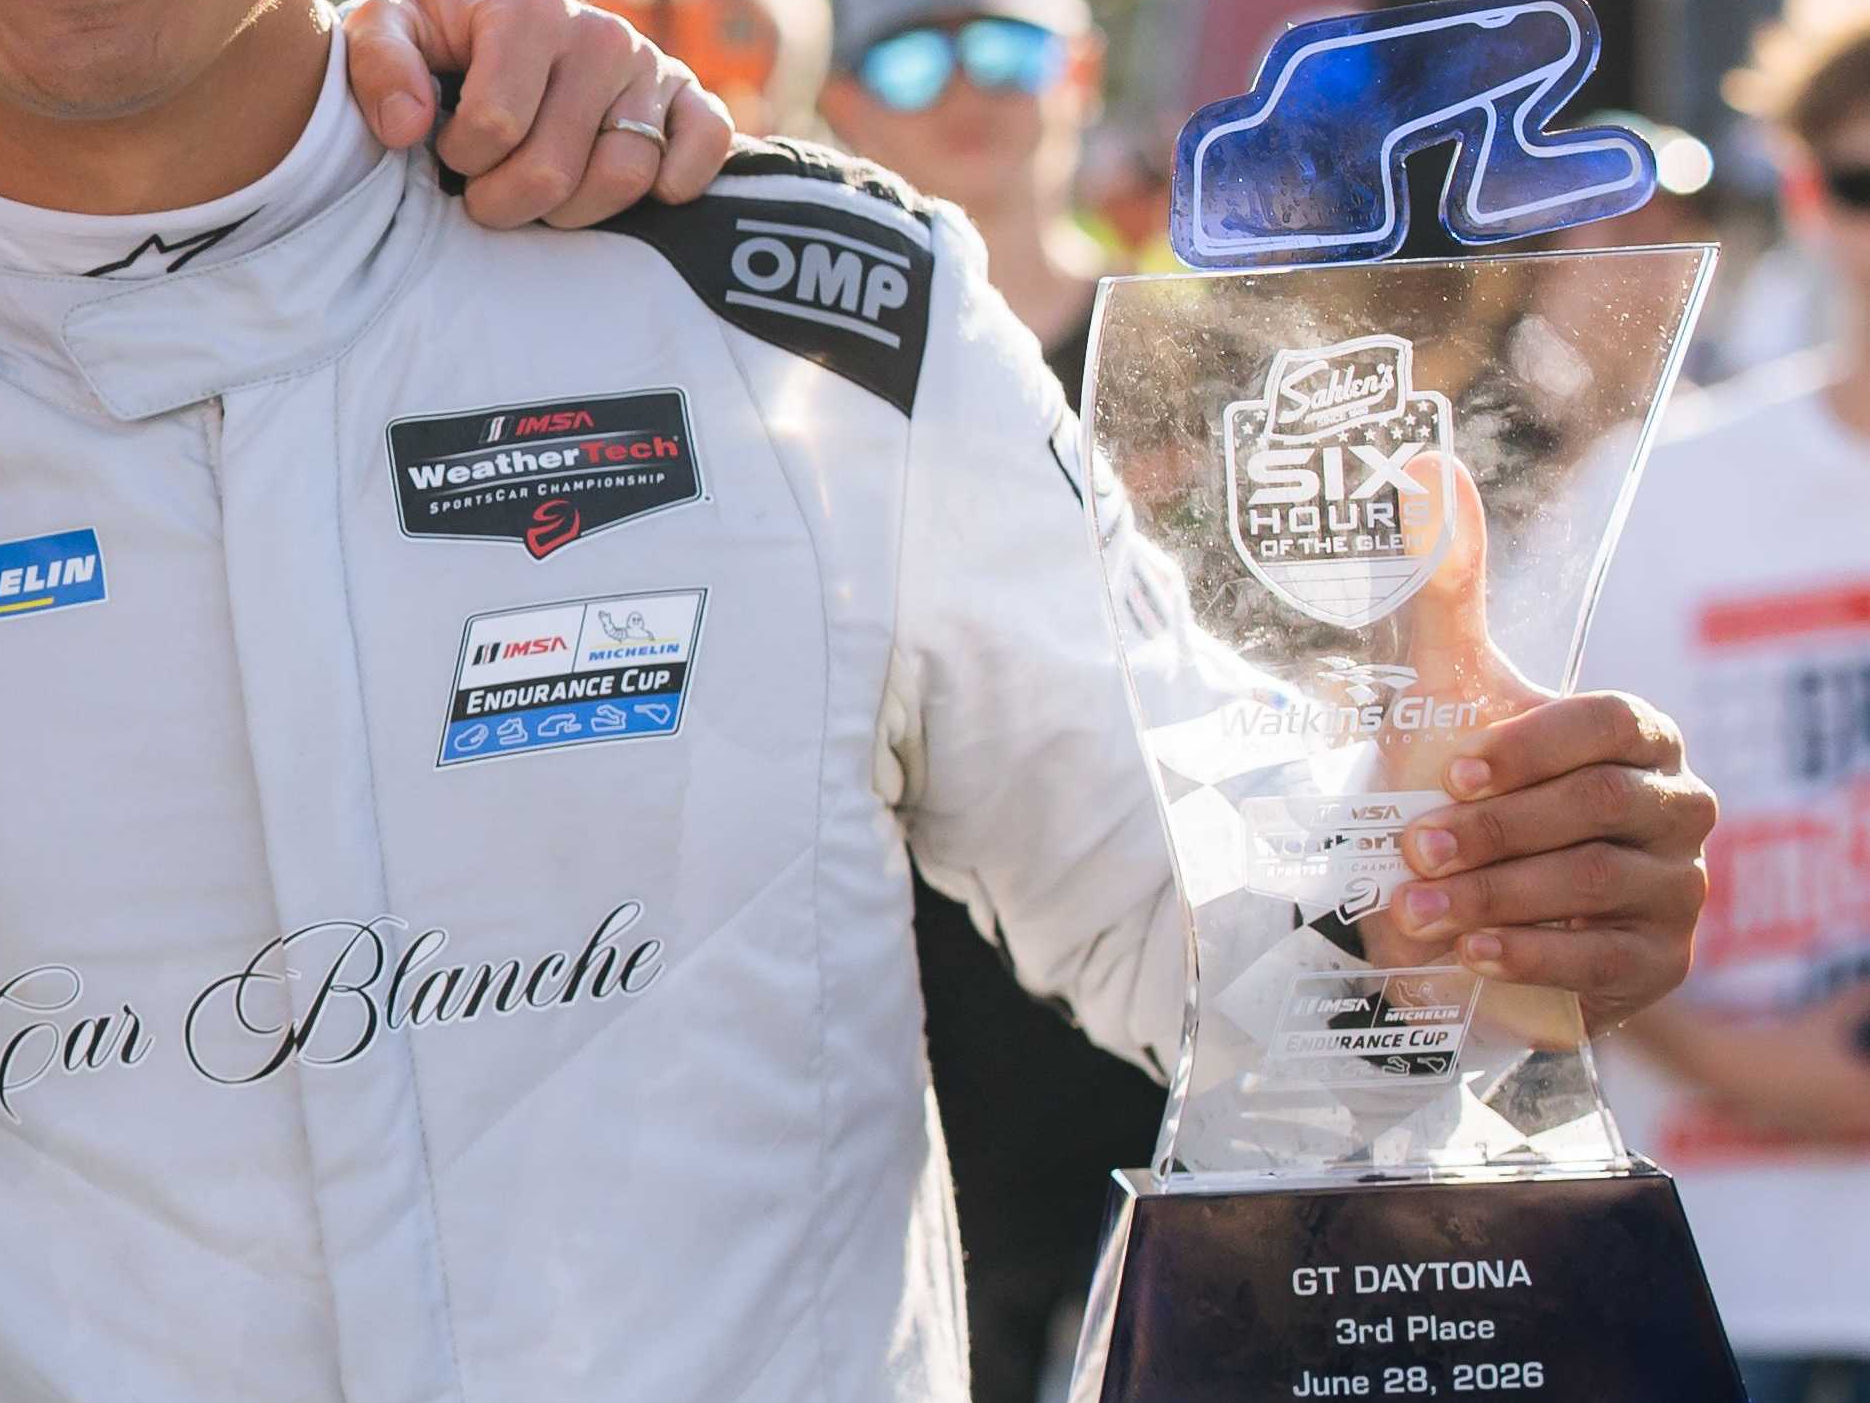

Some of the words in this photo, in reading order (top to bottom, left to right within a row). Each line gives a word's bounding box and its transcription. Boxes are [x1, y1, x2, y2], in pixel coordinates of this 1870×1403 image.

[731, 236, 909, 321] OMP
[1278, 360, 1395, 424] Sahlen's
[515, 411, 595, 437] IMSA
[407, 436, 679, 490] WeatherTech
[1247, 441, 1430, 506] SIX
[537, 472, 666, 497] CHAMPIONSHIP
[1249, 500, 1429, 536] HOURS
[1260, 539, 1294, 557] OF
[1298, 535, 1349, 554] THE
[503, 637, 568, 660] IMSA
[588, 644, 680, 662] MICHELIN
[466, 674, 613, 715] ENDURANCE
[620, 668, 671, 694] CUP
[1220, 702, 1383, 737] Watkins
[1392, 695, 1477, 730] Glen
[185, 900, 665, 1084] Blanche
[1384, 1009, 1460, 1022] MICHELIN
[1286, 1032, 1405, 1053] ENDURANCE
[1408, 1028, 1449, 1047] CUP
[1292, 1266, 1341, 1296] GT
[1354, 1258, 1533, 1294] DAYTONA
[1335, 1316, 1394, 1345] 3rd
[1407, 1315, 1496, 1343] Place
[1292, 1370, 1370, 1397] June
[1383, 1366, 1437, 1396] 28,
[1452, 1362, 1545, 1391] 2026
